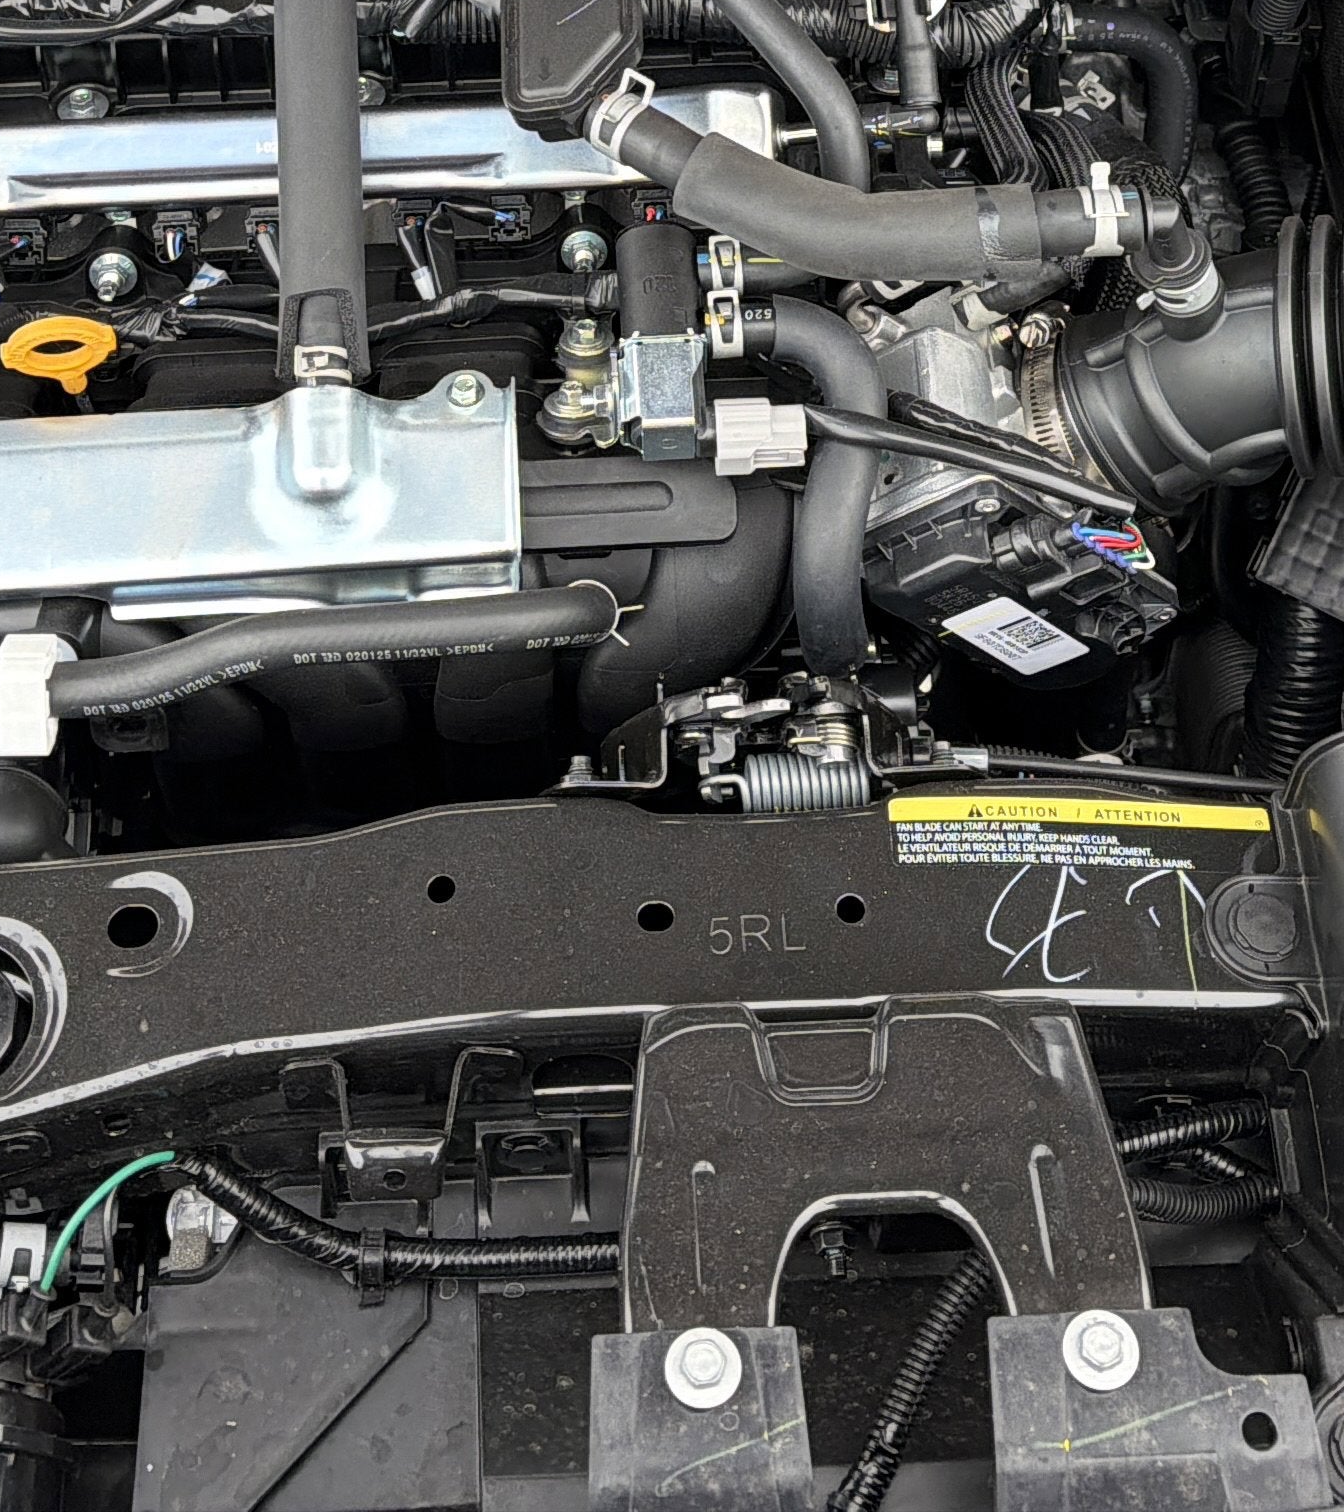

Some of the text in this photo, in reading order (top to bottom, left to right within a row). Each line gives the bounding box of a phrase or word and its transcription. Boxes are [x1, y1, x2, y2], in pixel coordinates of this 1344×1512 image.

[525, 638, 550, 649] DOT
[293, 652, 317, 664] DOT
[345, 650, 391, 661] 020125
[83, 704, 106, 716] DOT
[131, 691, 175, 711] 020125
[985, 805, 1057, 817] CAUTION
[1094, 809, 1181, 823] ATTENTION
[896, 822, 913, 831] FAN
[914, 822, 942, 831] BLADE
[943, 822, 962, 831] CAN
[963, 822, 988, 831] START
[990, 822, 1000, 831] AT
[897, 833, 910, 842] TO
[911, 833, 932, 842] HELP
[934, 833, 961, 842] AVOID
[962, 833, 1006, 842] PERSONAL
[1039, 833, 1060, 842] KEEP
[1060, 834, 1090, 843] HANDS
[1091, 835, 1120, 845] CLEAR.
[898, 843, 908, 852] LE
[910, 843, 972, 852] VENTILATEUR
[973, 843, 1007, 853] RISQUE
[1009, 843, 1021, 852] DE
[1083, 845, 1107, 855] TOUT
[1109, 847, 1154, 857] MOMENT.
[898, 854, 926, 863] POUR
[959, 854, 990, 863] TOUTE
[991, 854, 1039, 864] BLESSURE,
[1040, 854, 1053, 863] NE
[1056, 854, 1072, 863] PAS
[1074, 855, 1086, 864] EN
[1087, 856, 1144, 867] APPROCHER
[1145, 858, 1161, 867] LES
[1162, 859, 1196, 869] MAINS.
[709, 913, 807, 954] 5RL
